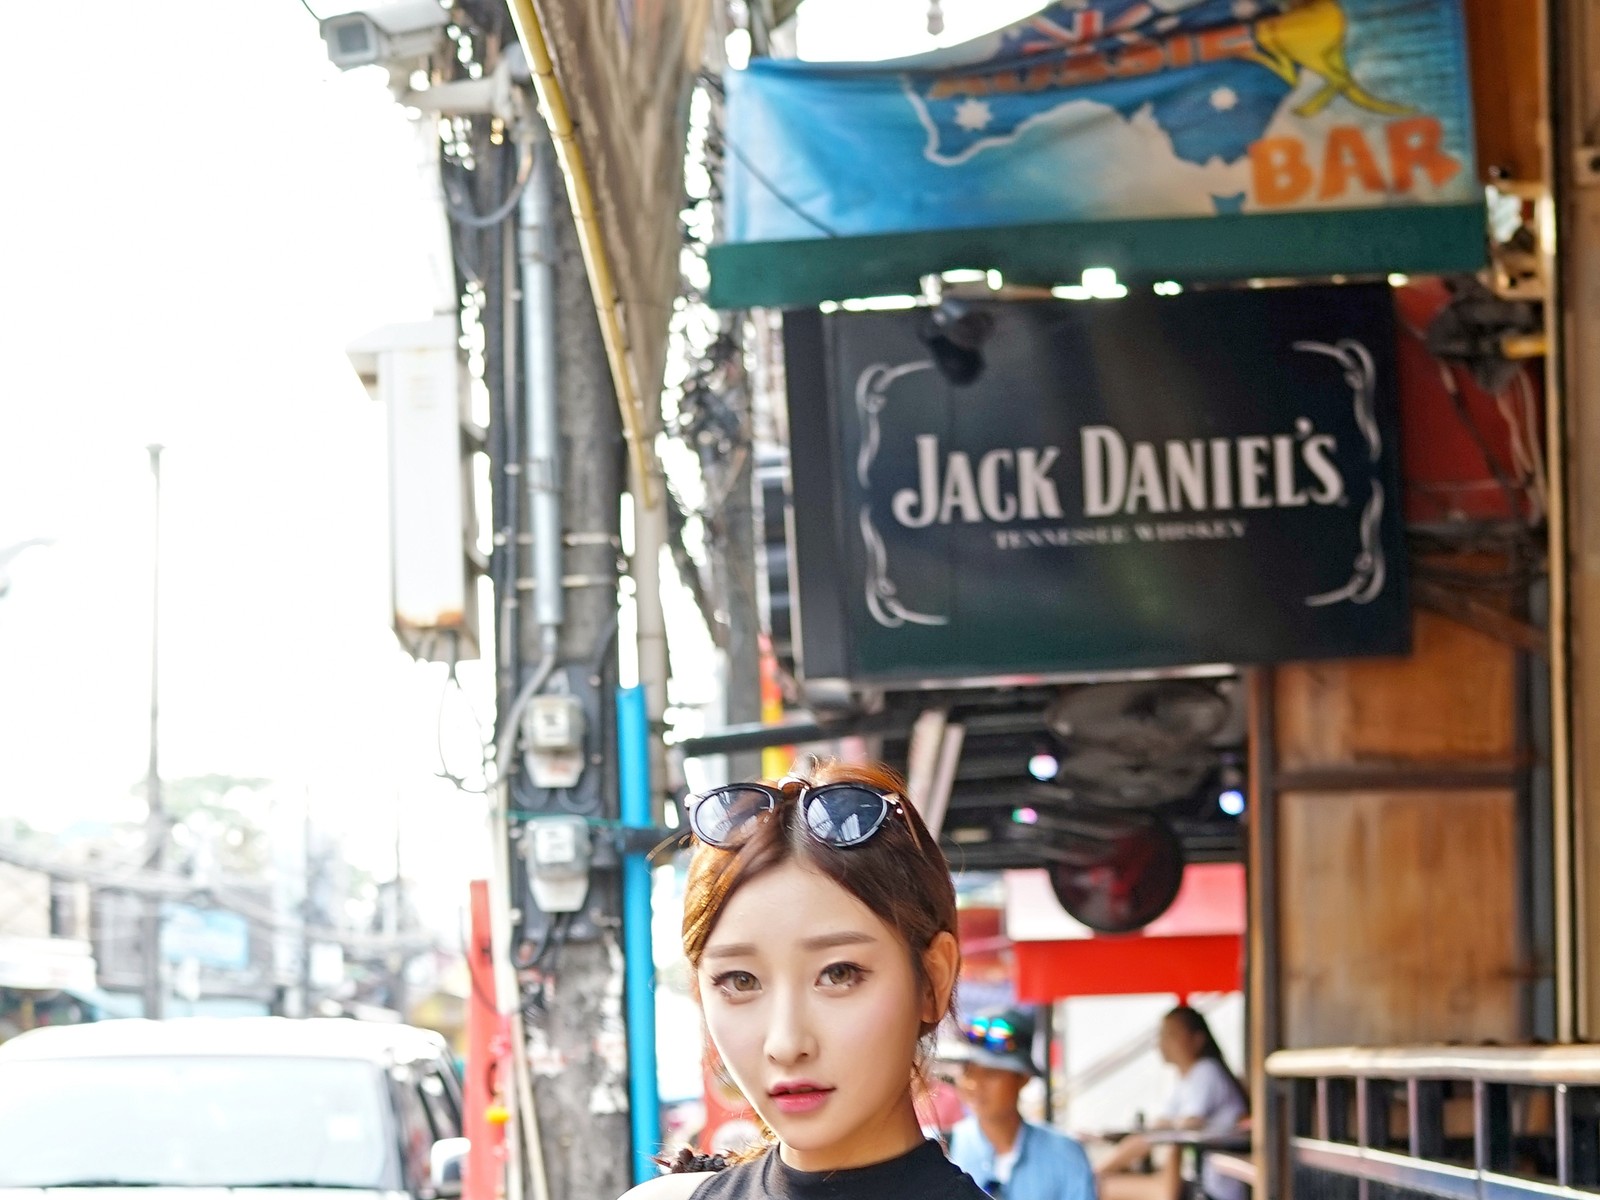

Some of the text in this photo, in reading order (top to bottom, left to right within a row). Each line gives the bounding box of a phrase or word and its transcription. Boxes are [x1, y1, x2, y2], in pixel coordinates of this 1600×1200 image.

[1247, 116, 1461, 206] BAR
[892, 416, 1344, 529] JACK DANIEL'S
